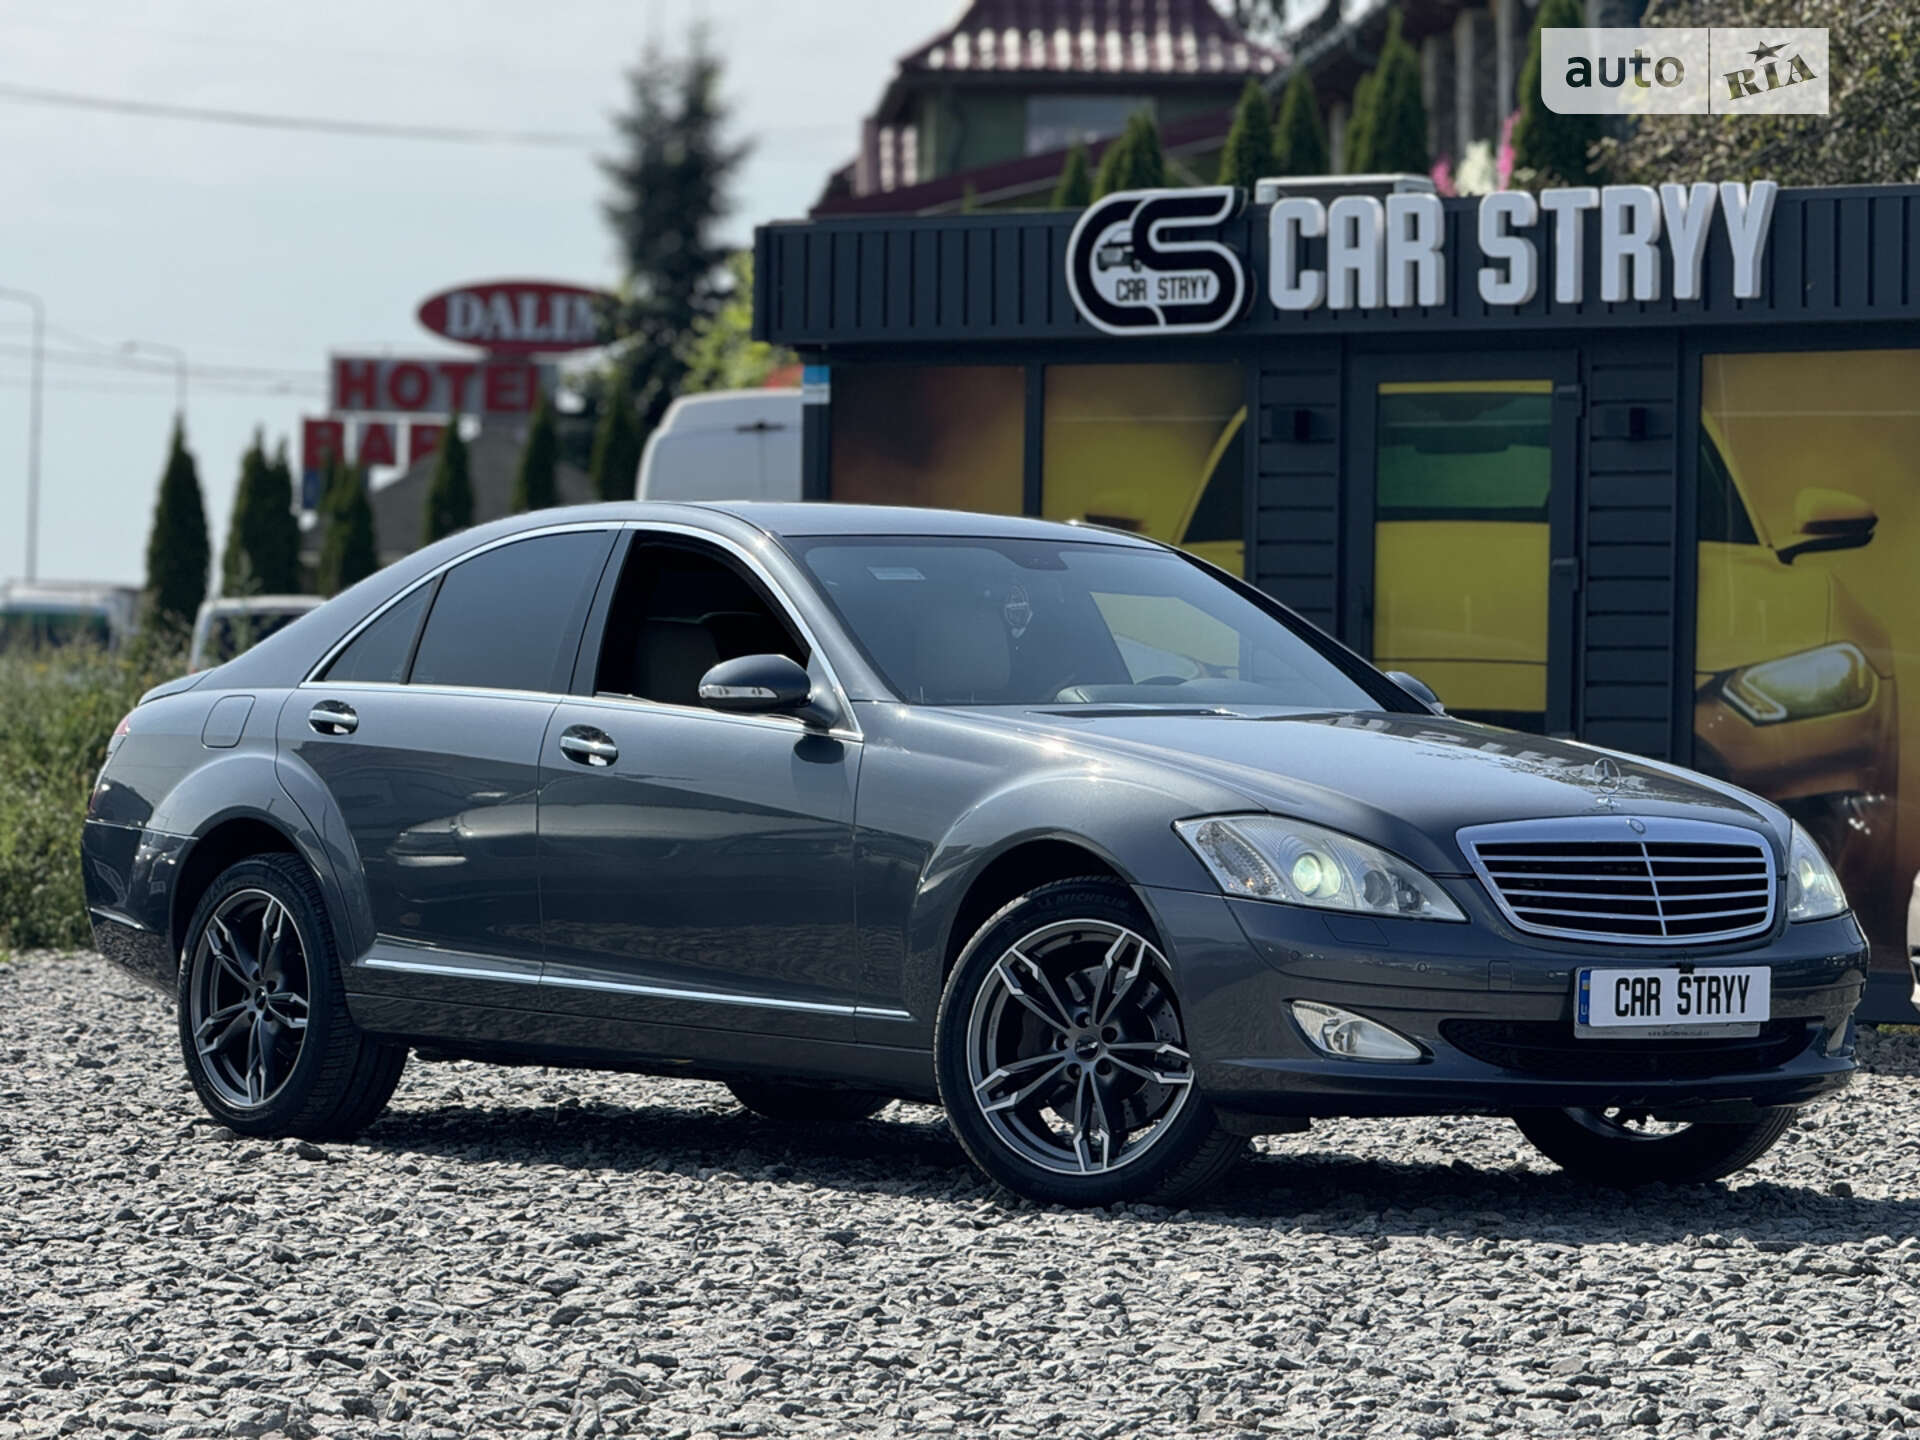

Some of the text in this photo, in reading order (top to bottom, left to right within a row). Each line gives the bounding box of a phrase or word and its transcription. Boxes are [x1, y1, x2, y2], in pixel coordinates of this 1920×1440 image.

[1269, 180, 1778, 310] CAR STRYY
[1116, 275, 1211, 301] CAR STRYY
[1615, 974, 1751, 1017] CAR STRYY
